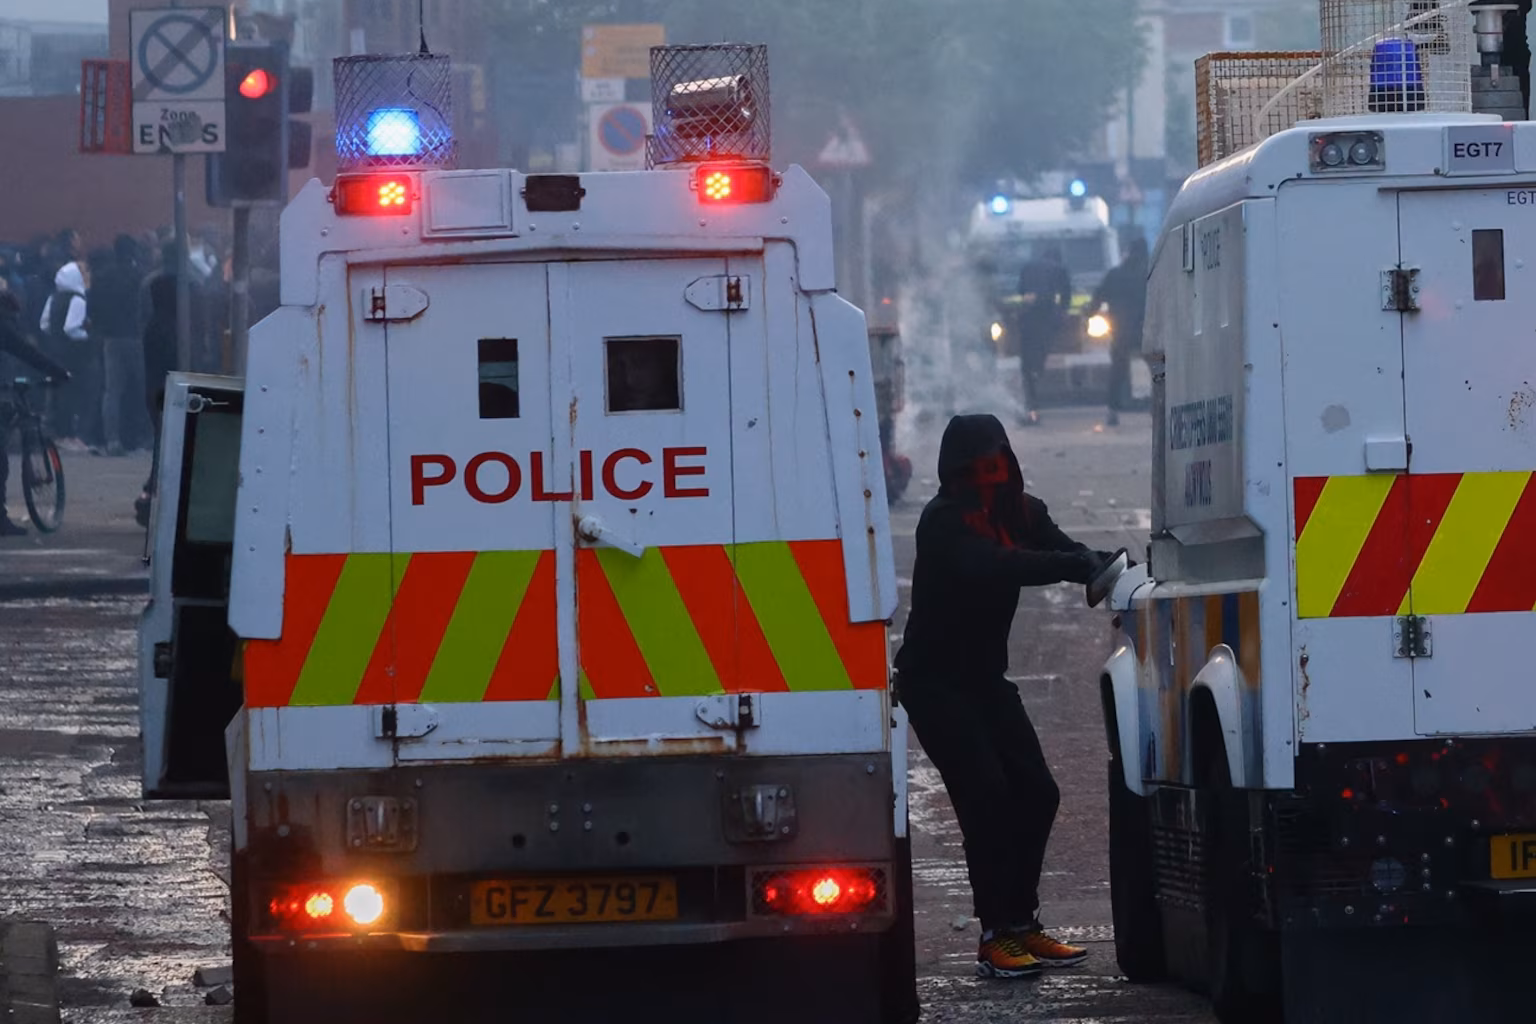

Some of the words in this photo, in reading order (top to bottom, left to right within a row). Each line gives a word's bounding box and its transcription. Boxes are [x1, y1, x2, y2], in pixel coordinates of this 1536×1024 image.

[140, 123, 219, 145] ENS
[1453, 142, 1503, 158] EGT7
[410, 446, 709, 505] POLICE
[485, 885, 555, 919] GFZ
[566, 880, 660, 916] 3797
